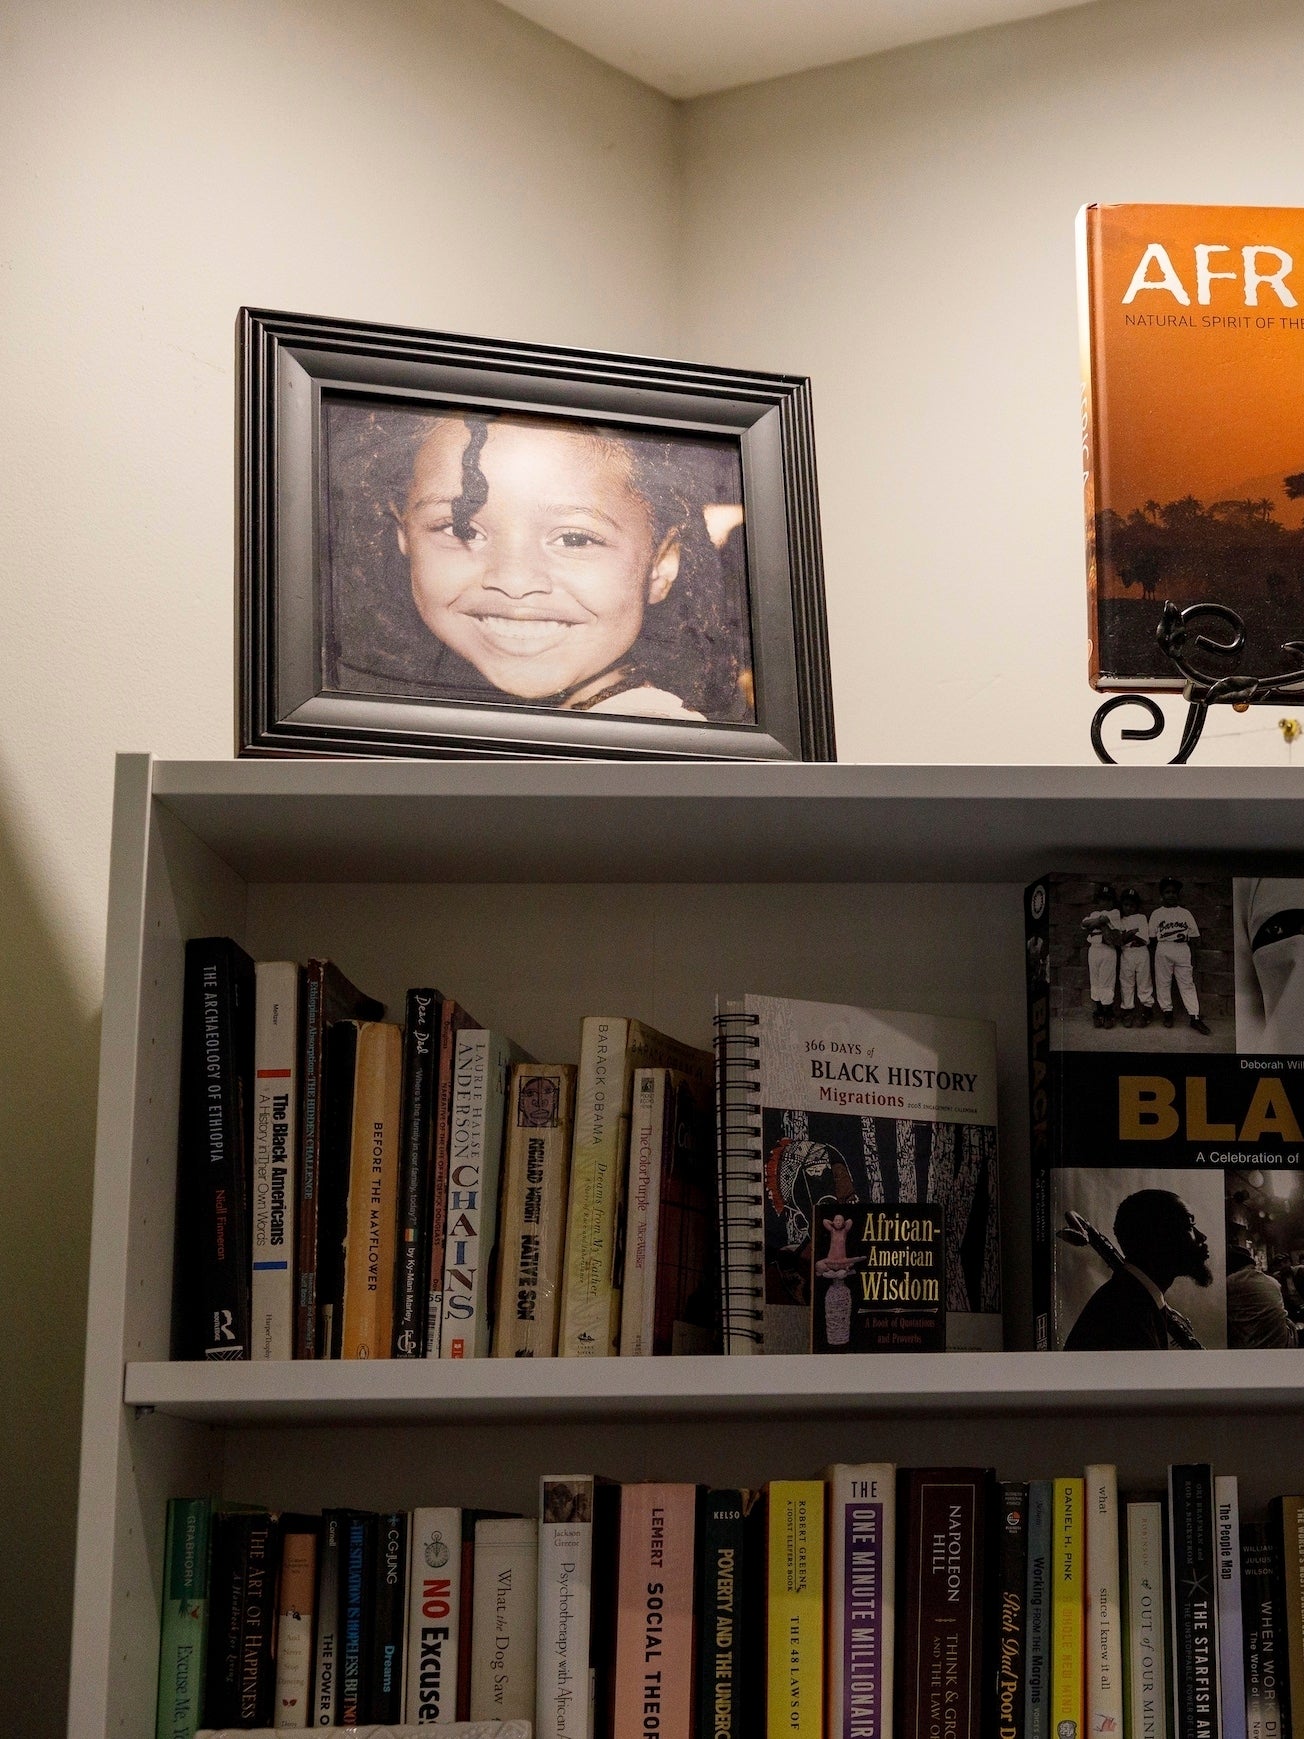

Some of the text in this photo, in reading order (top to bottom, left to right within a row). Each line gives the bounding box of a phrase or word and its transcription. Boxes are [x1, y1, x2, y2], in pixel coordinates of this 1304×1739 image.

[1125, 313, 1197, 328] NATURAL
[1202, 315, 1251, 329] SPIRIT
[1255, 316, 1275, 329] OF
[203, 966, 224, 1162] THE ARCHAEOLOGY OF ETHIOPIA
[593, 1024, 608, 1145] BARACK OBAMA
[804, 1040, 875, 1058] 366 DAYS of
[811, 1060, 978, 1092] BLACK HISTORY
[1240, 1060, 1283, 1070] Deborah
[304, 981, 319, 1200] Ethiopian Absorption: THE HIDDEN CHALLENGE
[454, 1042, 472, 1159] ANDERSON
[471, 1043, 486, 1158] LAURIE HALSE
[820, 1087, 904, 1107] Migrations
[257, 1095, 270, 1247] A History in Their Own Words
[270, 1094, 288, 1245] The Black Americans
[524, 1138, 545, 1224] RICHARD WRIGHT
[636, 1126, 653, 1211] The Color Purple
[1196, 1153, 1205, 1162] A
[1209, 1152, 1282, 1164] Celebration
[1287, 1153, 1299, 1164] of
[214, 1190, 227, 1260] Niall Finneran
[368, 1123, 382, 1291] BEFORE THE MAYFLOWER
[445, 1165, 478, 1319] CHAINS
[861, 1212, 940, 1241] African-
[404, 1259, 416, 1293] Ky-Mani
[406, 1247, 416, 1258] by
[518, 1234, 540, 1320] NATIVE SON
[860, 1271, 939, 1301] Wisdom
[867, 1246, 933, 1266] American
[404, 1295, 414, 1321] Marley
[713, 1510, 740, 1520] KELSO
[851, 1481, 878, 1497] THE
[1297, 1508, 1304, 1523] THE
[184, 1515, 196, 1587] GRABHORN
[329, 1521, 337, 1547] Cornell
[651, 1508, 664, 1568] LEMERT
[851, 1509, 876, 1620] ONE MINUTE
[932, 1533, 946, 1574] HILL
[947, 1505, 962, 1602] NAPOLEON
[1064, 1487, 1073, 1581] DANIEL H. PINK
[1220, 1504, 1232, 1580] The People Map
[241, 1528, 268, 1719] THE ART OF HAPPINESS
[422, 1579, 451, 1618] NO
[645, 1582, 664, 1663] SOCIAL
[715, 1548, 735, 1678] POVERTY AND THE
[321, 1634, 333, 1710] THE POWER
[383, 1645, 395, 1692] Dreams
[490, 1569, 512, 1704] What the Dog Saw
[791, 1616, 800, 1730] THE 48 LAWS OF
[945, 1633, 959, 1703] THINK &
[1194, 1601, 1209, 1713] THE STARFISH
